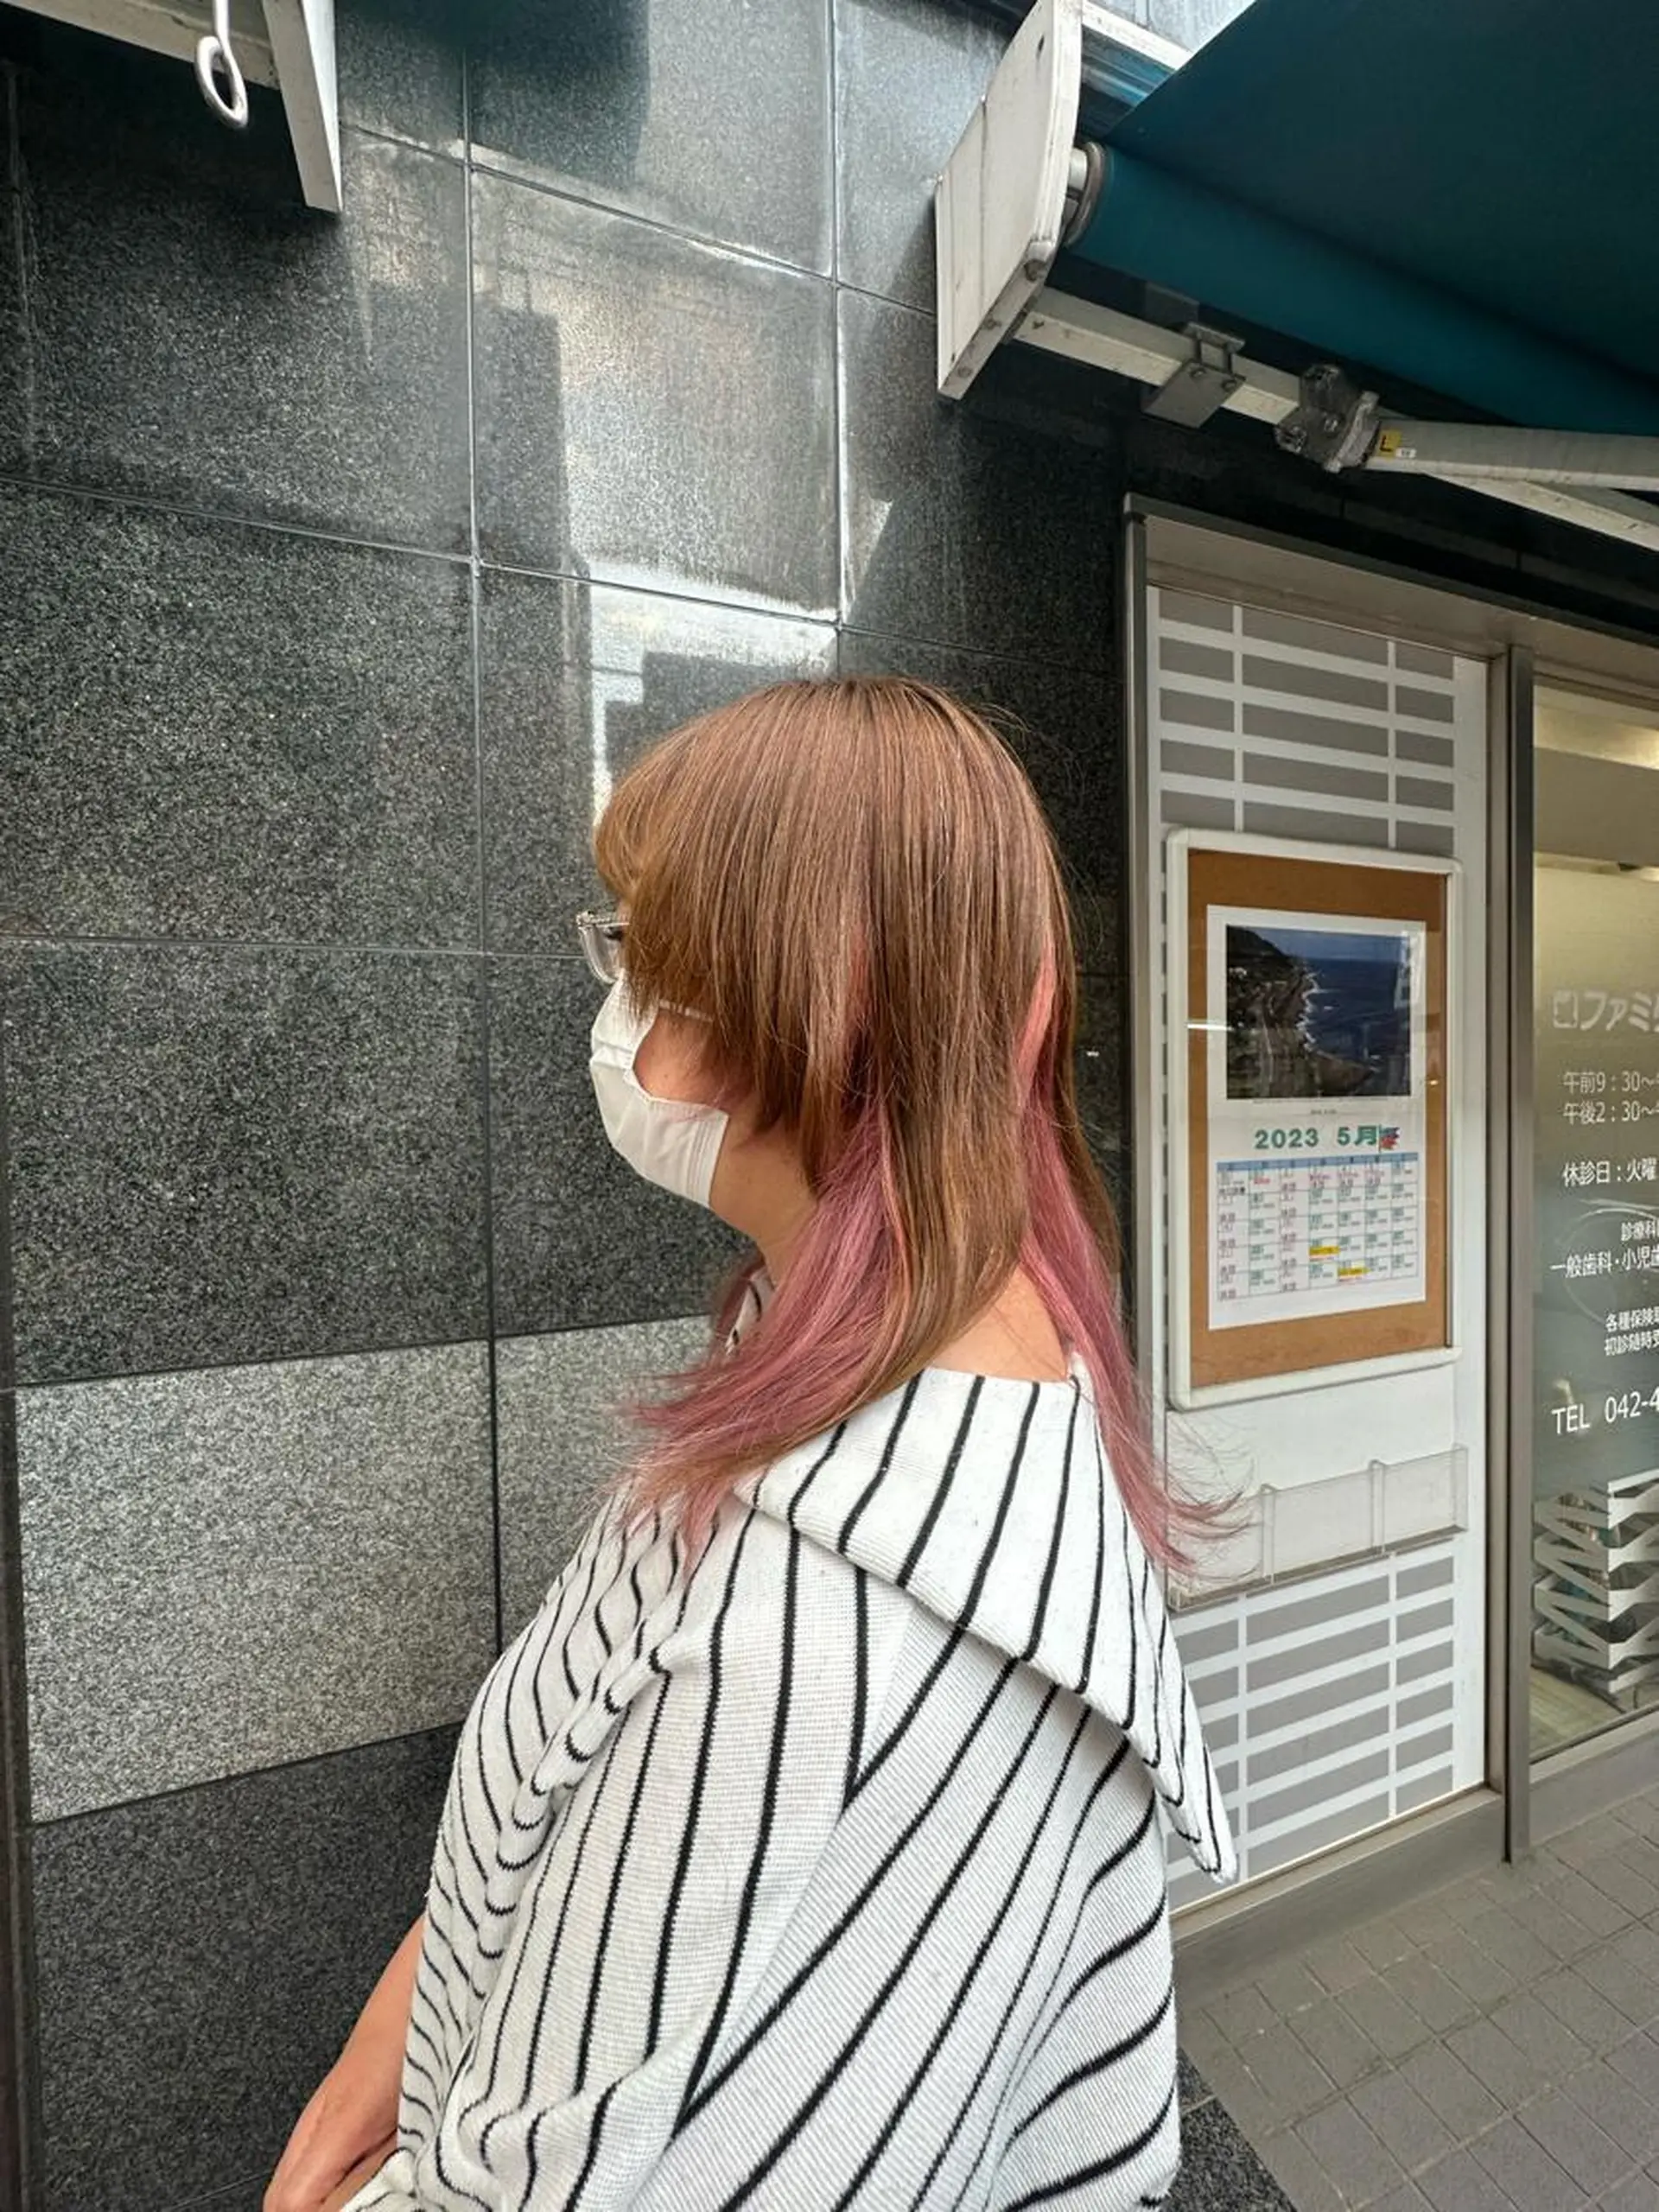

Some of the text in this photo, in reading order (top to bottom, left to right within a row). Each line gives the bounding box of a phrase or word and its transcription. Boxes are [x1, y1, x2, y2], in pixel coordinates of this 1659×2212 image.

[1580, 991, 1659, 1032] ファミ
[1255, 1125, 1377, 1149] 2023 5月
[1620, 1219, 1659, 1243] 診療科
[1551, 1386, 1659, 1434] TEL 042-4
